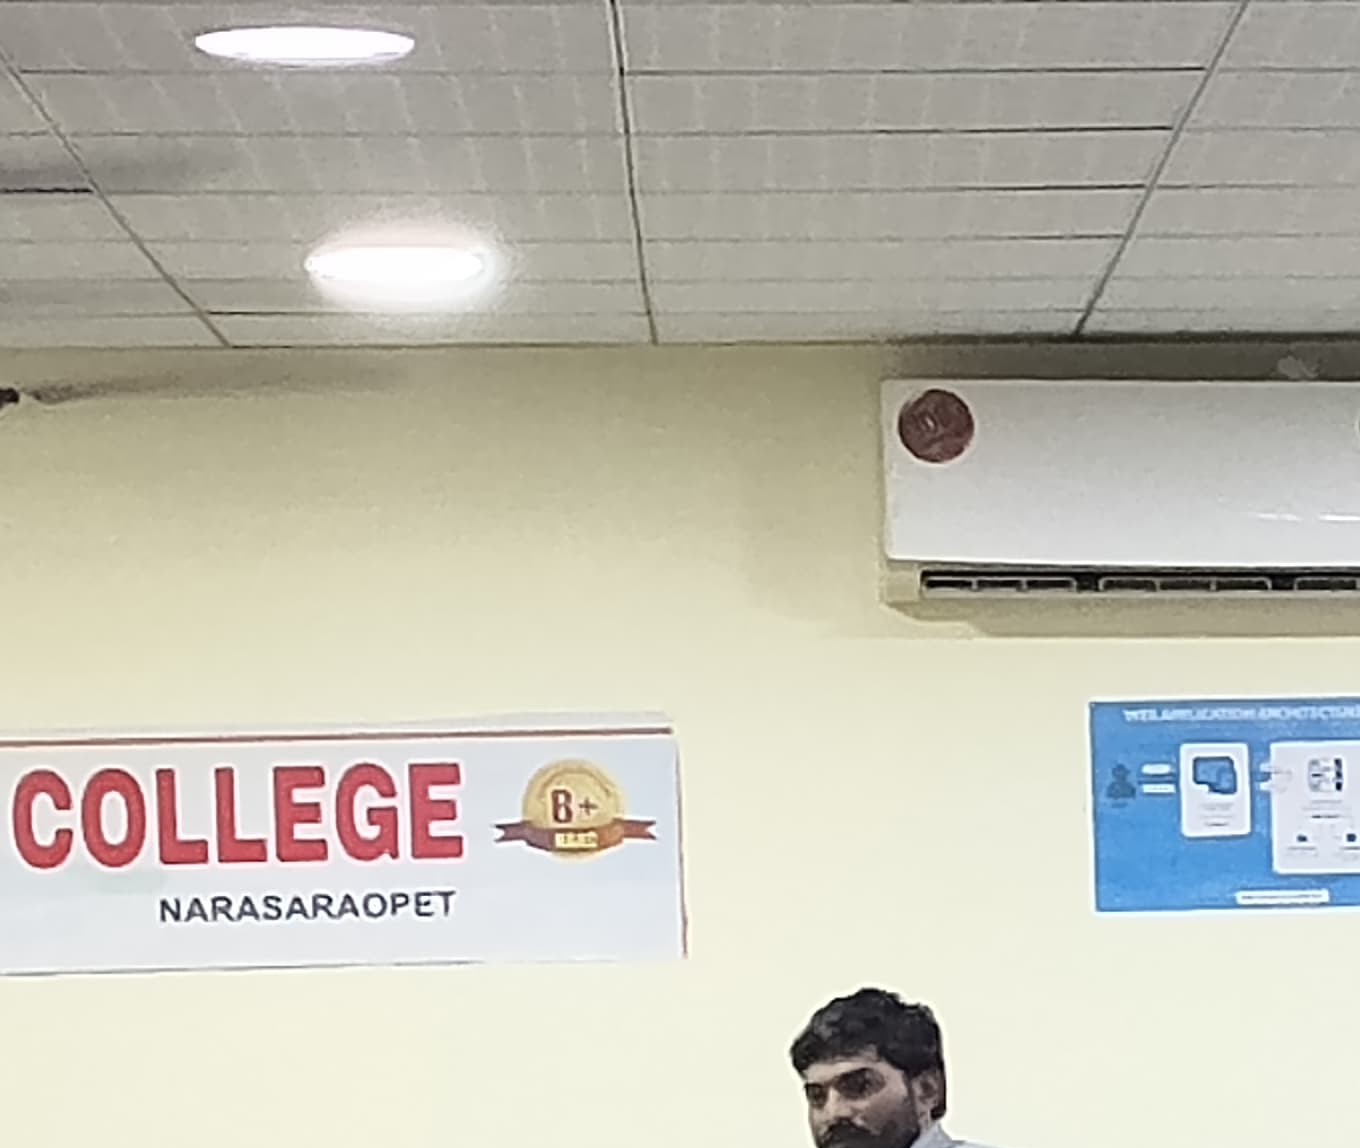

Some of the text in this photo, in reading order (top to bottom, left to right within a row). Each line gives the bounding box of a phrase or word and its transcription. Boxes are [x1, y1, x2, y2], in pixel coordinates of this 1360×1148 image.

[12, 763, 464, 869] COLLEGE
[551, 788, 598, 823] B+
[160, 891, 456, 923] NARASARAOPET
